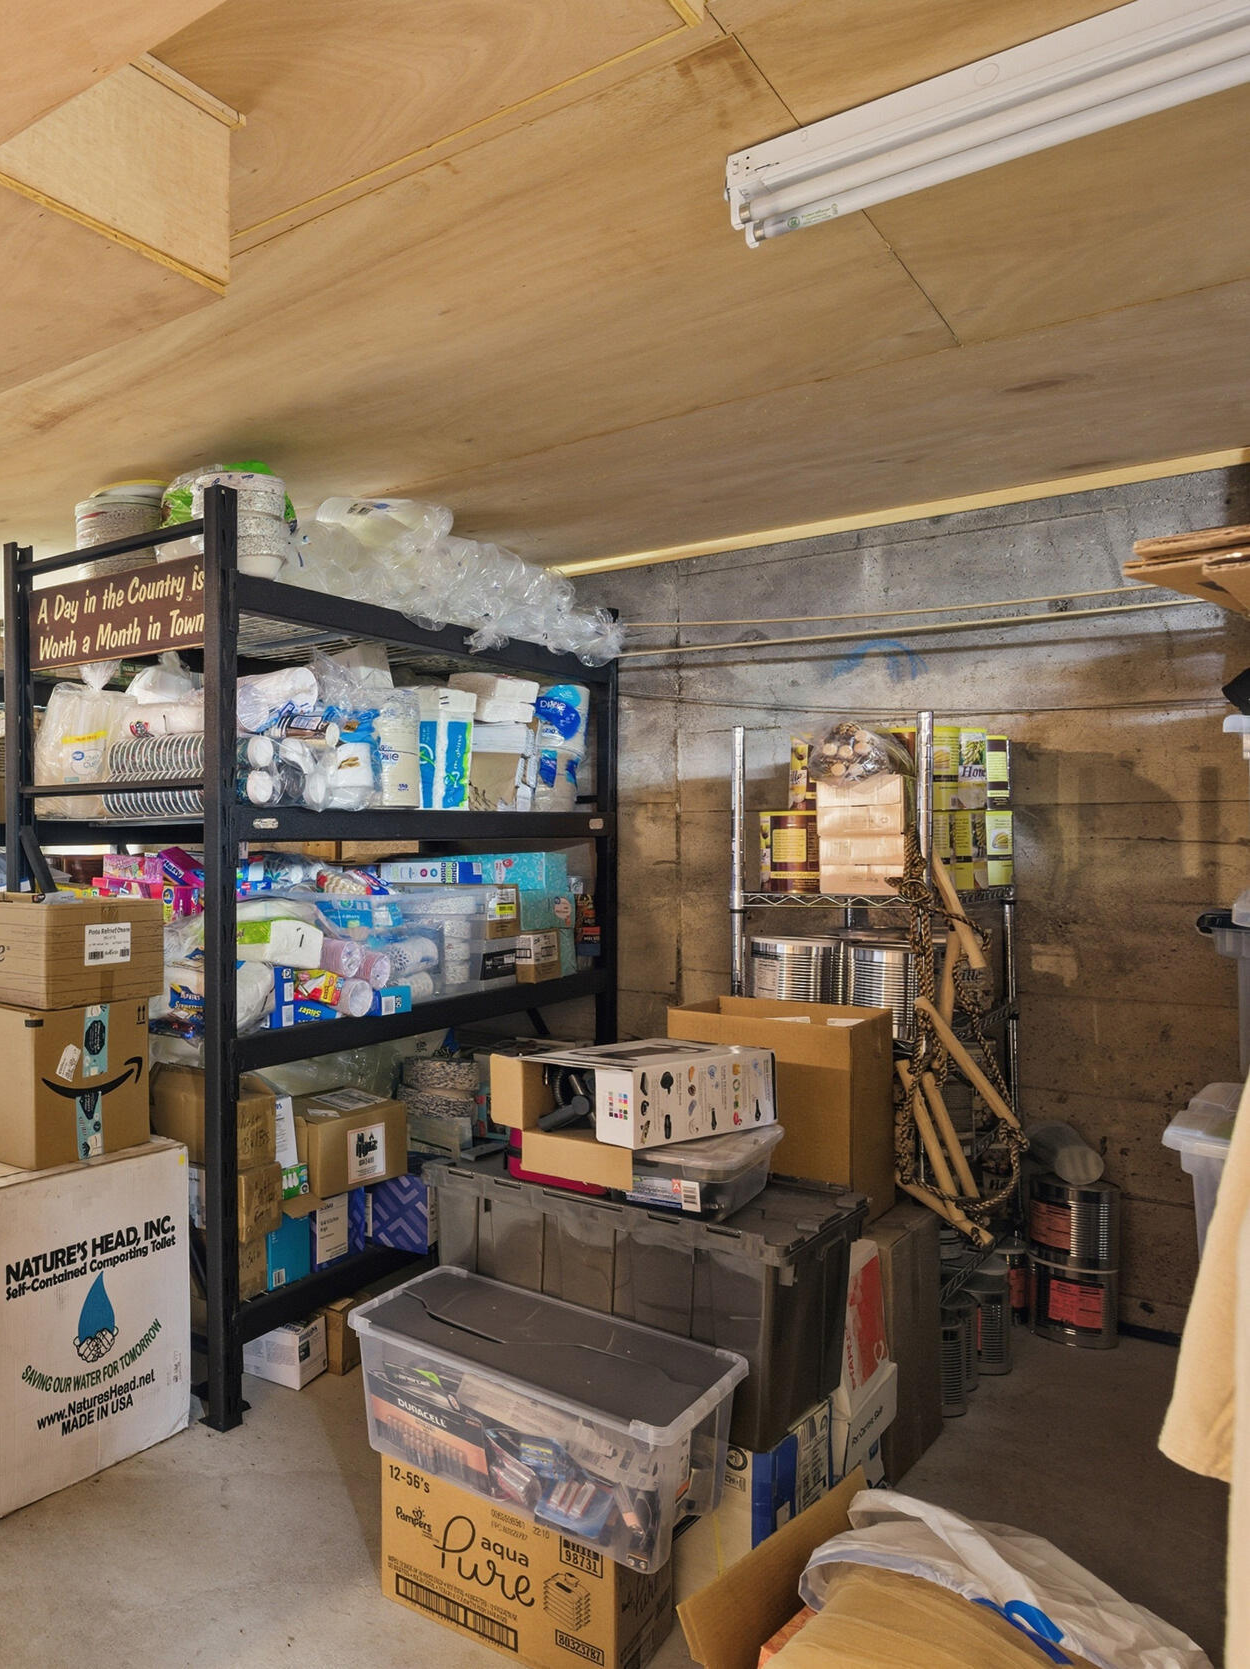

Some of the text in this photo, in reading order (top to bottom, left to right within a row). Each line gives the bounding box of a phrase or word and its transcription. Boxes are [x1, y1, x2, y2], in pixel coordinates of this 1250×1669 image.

[37, 564, 205, 625] A Day in the Country is
[39, 609, 205, 661] Worth a Month in Town
[163, 860, 185, 878] Hefty
[298, 1006, 321, 1018] Slider
[5, 1215, 176, 1286] NATURE'S HEAD, INC.
[5, 1234, 176, 1301] Self-Contained Composting Toilet
[21, 1318, 162, 1393] SAVING OUR WATER FOR TOMORROW
[37, 1368, 156, 1431] www.NaturesHead.net
[61, 1393, 134, 1436] MADE IN USA
[397, 1397, 448, 1429] DURACELL
[389, 1464, 431, 1494] 12-56's
[395, 1505, 433, 1534] Pampers
[433, 1515, 536, 1608] Pure
[481, 1536, 530, 1569] aqua
[565, 1549, 599, 1574] 98731
[557, 1632, 602, 1663] 80323787
